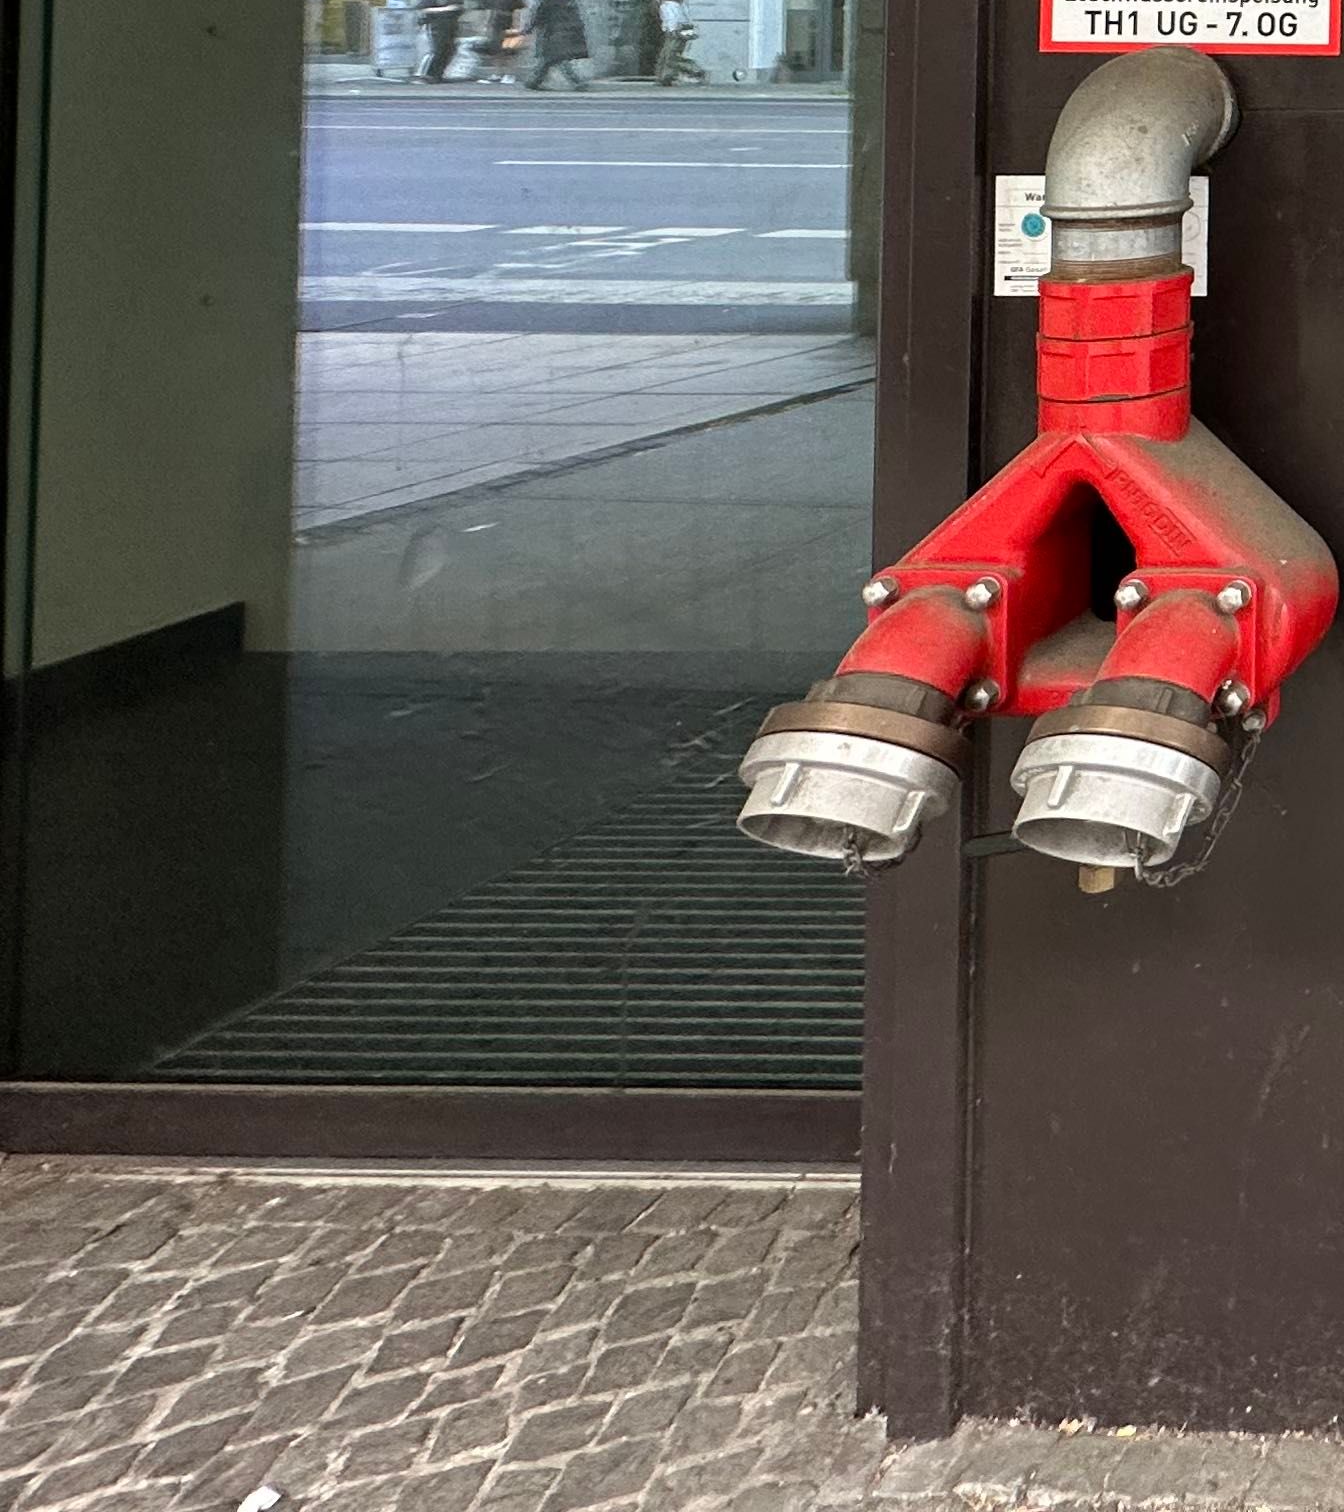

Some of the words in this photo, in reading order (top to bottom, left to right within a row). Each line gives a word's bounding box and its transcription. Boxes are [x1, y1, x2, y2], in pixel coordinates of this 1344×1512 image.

[1085, 11, 1138, 35] TH1
[1157, 11, 1198, 36] UG
[1226, 12, 1248, 36] 7.
[1257, 12, 1298, 37] OG
